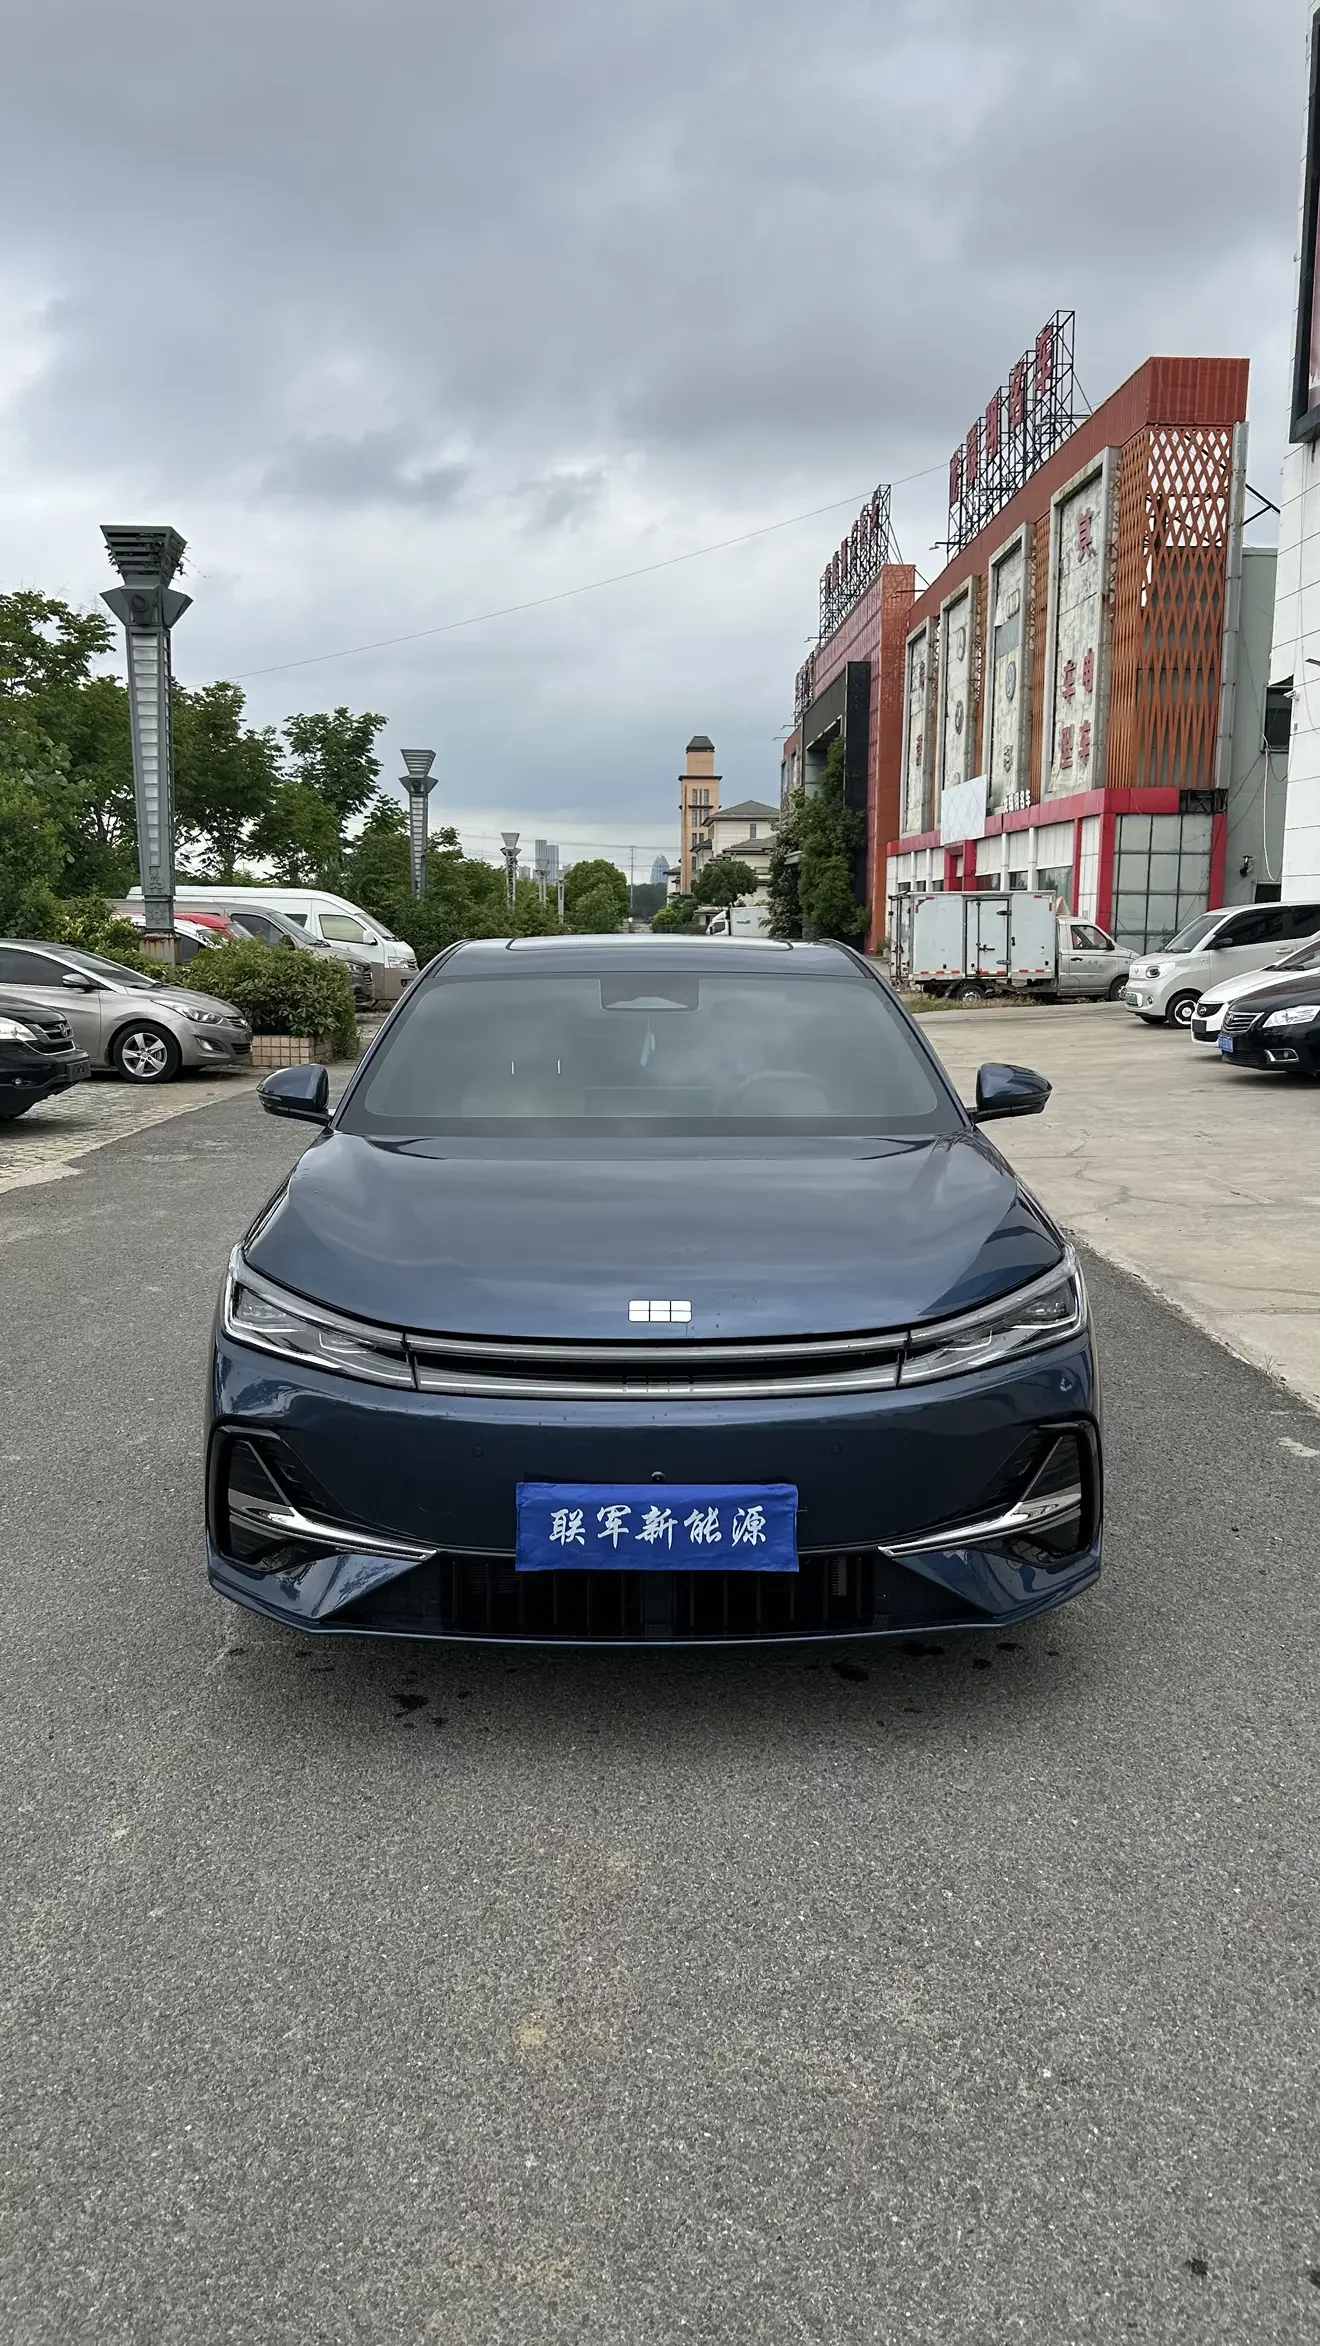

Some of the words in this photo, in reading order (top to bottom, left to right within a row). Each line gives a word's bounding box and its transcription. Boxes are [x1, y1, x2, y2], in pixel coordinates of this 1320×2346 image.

[548, 1504, 767, 1550] 联军新能源
